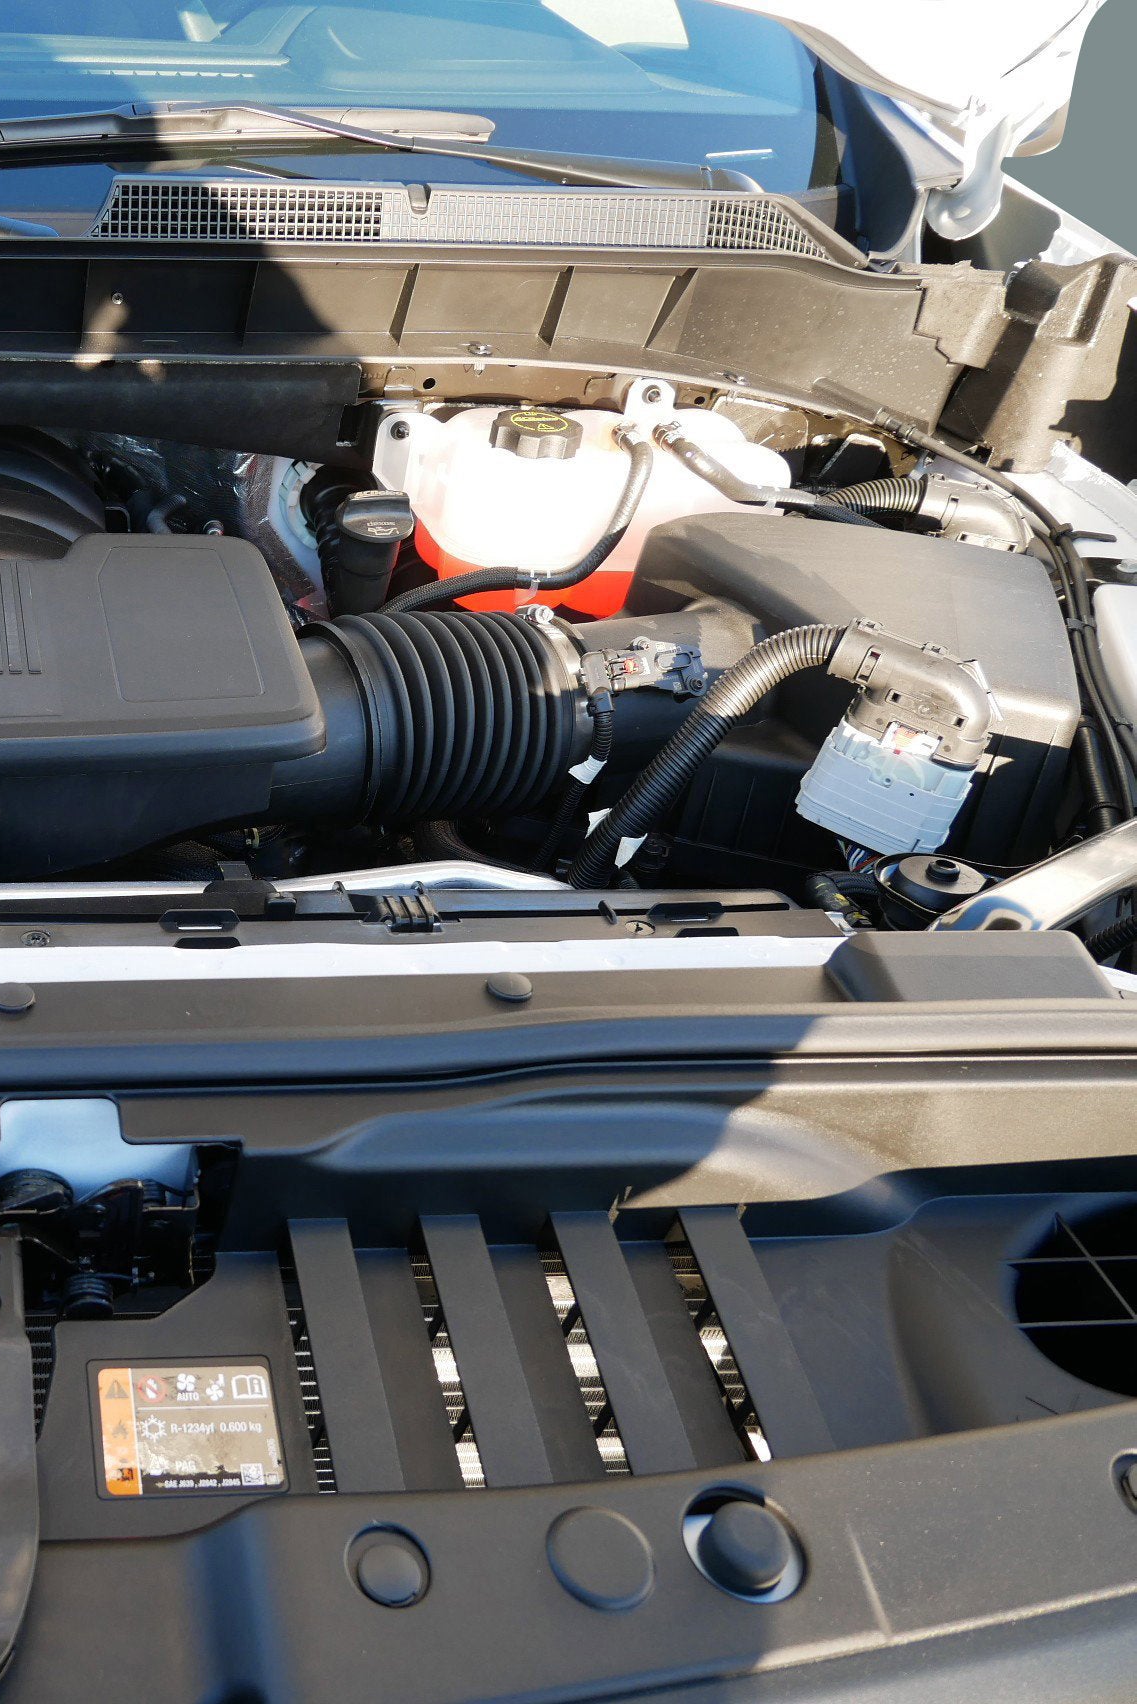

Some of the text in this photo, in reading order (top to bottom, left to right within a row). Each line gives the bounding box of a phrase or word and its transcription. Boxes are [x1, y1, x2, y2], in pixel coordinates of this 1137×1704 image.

[176, 1392, 200, 1401] AUTO
[170, 1420, 263, 1435] R-1234yf 0.600 kg
[175, 1460, 196, 1472] PAG
[164, 1479, 178, 1488] SAE
